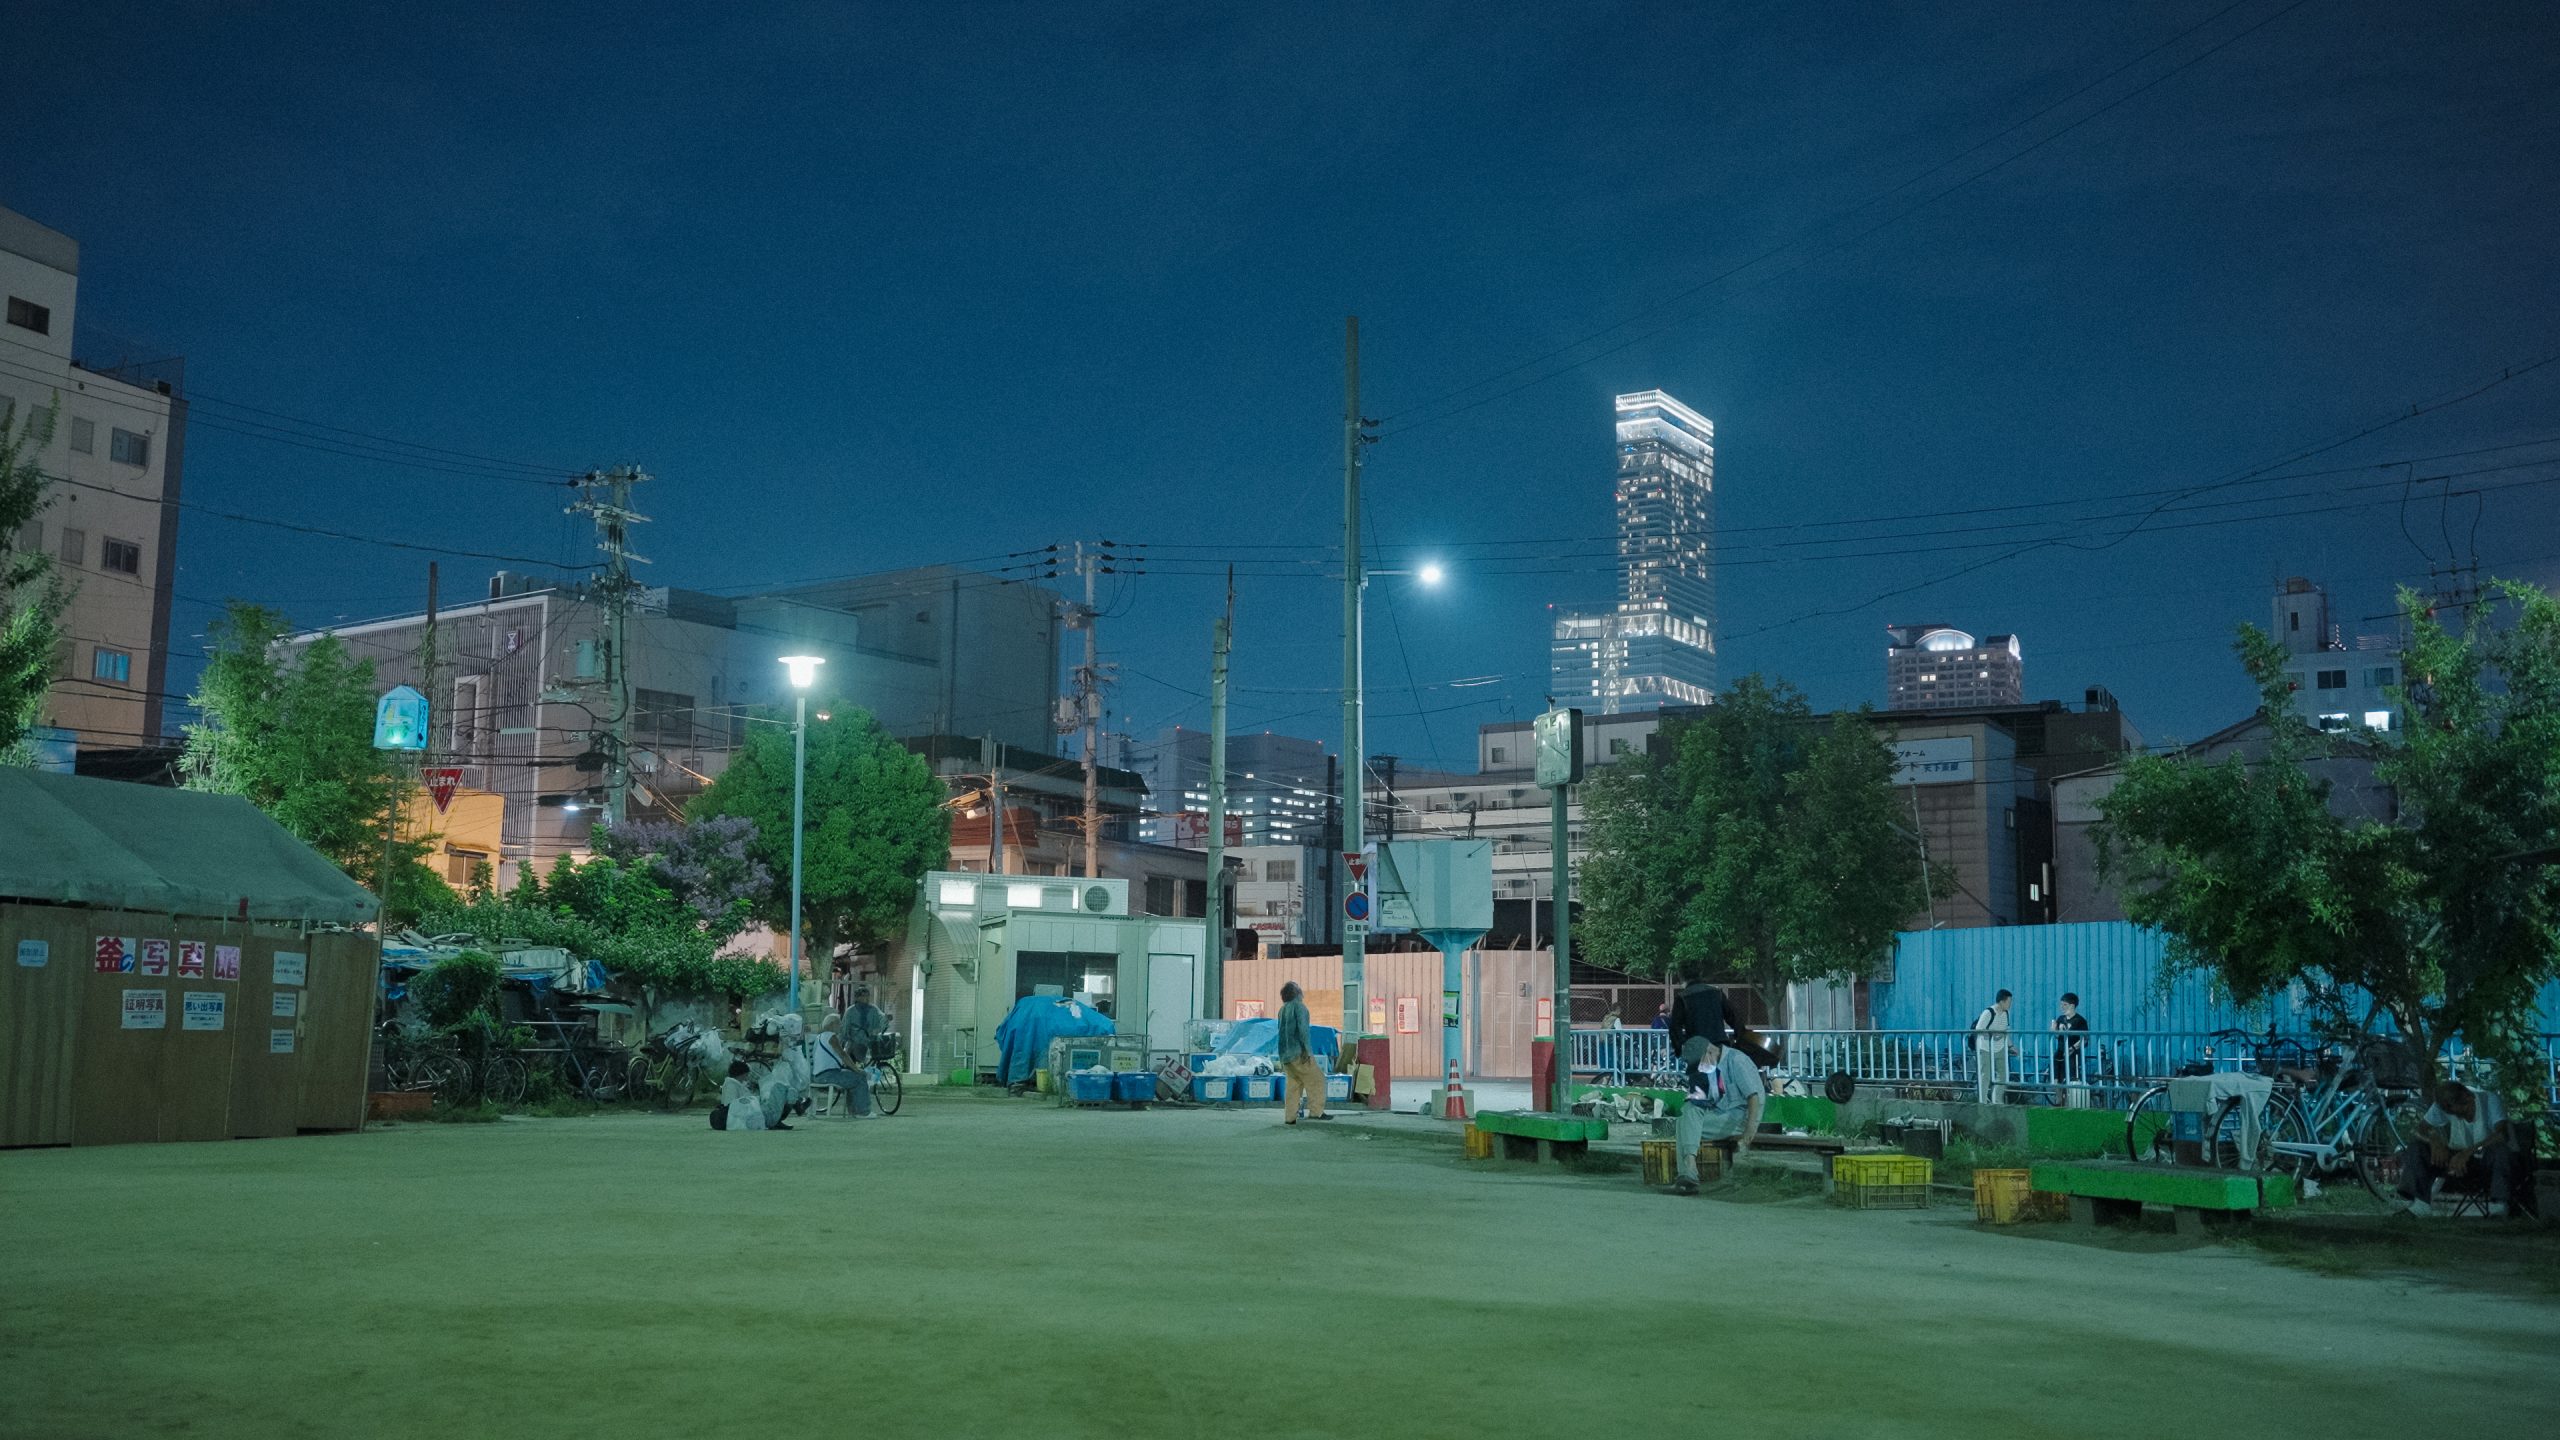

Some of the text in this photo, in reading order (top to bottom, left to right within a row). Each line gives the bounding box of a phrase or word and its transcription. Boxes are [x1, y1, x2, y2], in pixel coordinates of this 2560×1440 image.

[429, 776, 456, 787] 止まれ
[125, 999, 164, 1011] 証明写真
[185, 1001, 223, 1012] 思い出写真
